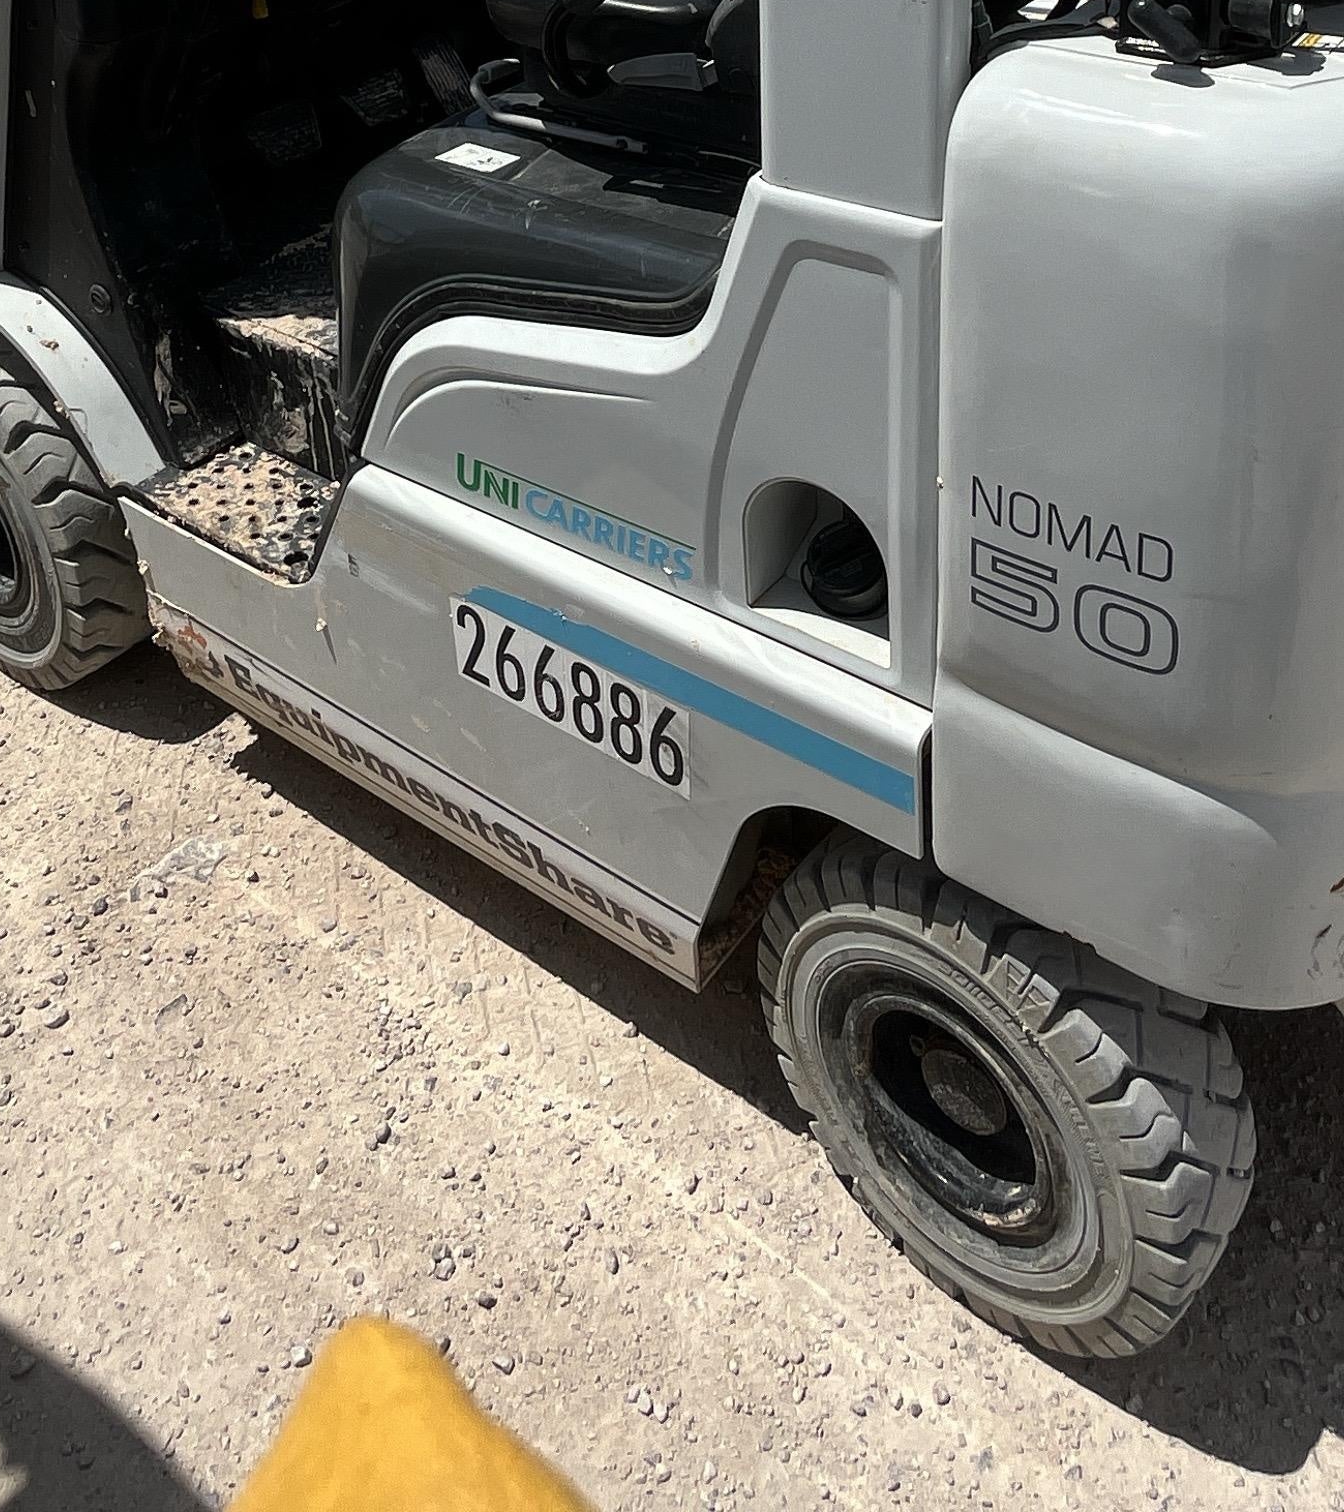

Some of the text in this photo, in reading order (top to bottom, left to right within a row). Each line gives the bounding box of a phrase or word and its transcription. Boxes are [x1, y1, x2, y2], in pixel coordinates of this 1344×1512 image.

[455, 452, 697, 581] UNICARRIERS
[970, 474, 1174, 583] NOMAD
[970, 535, 1180, 675] 50
[455, 603, 686, 787] 266886
[223, 654, 676, 956] EquipmentShare
